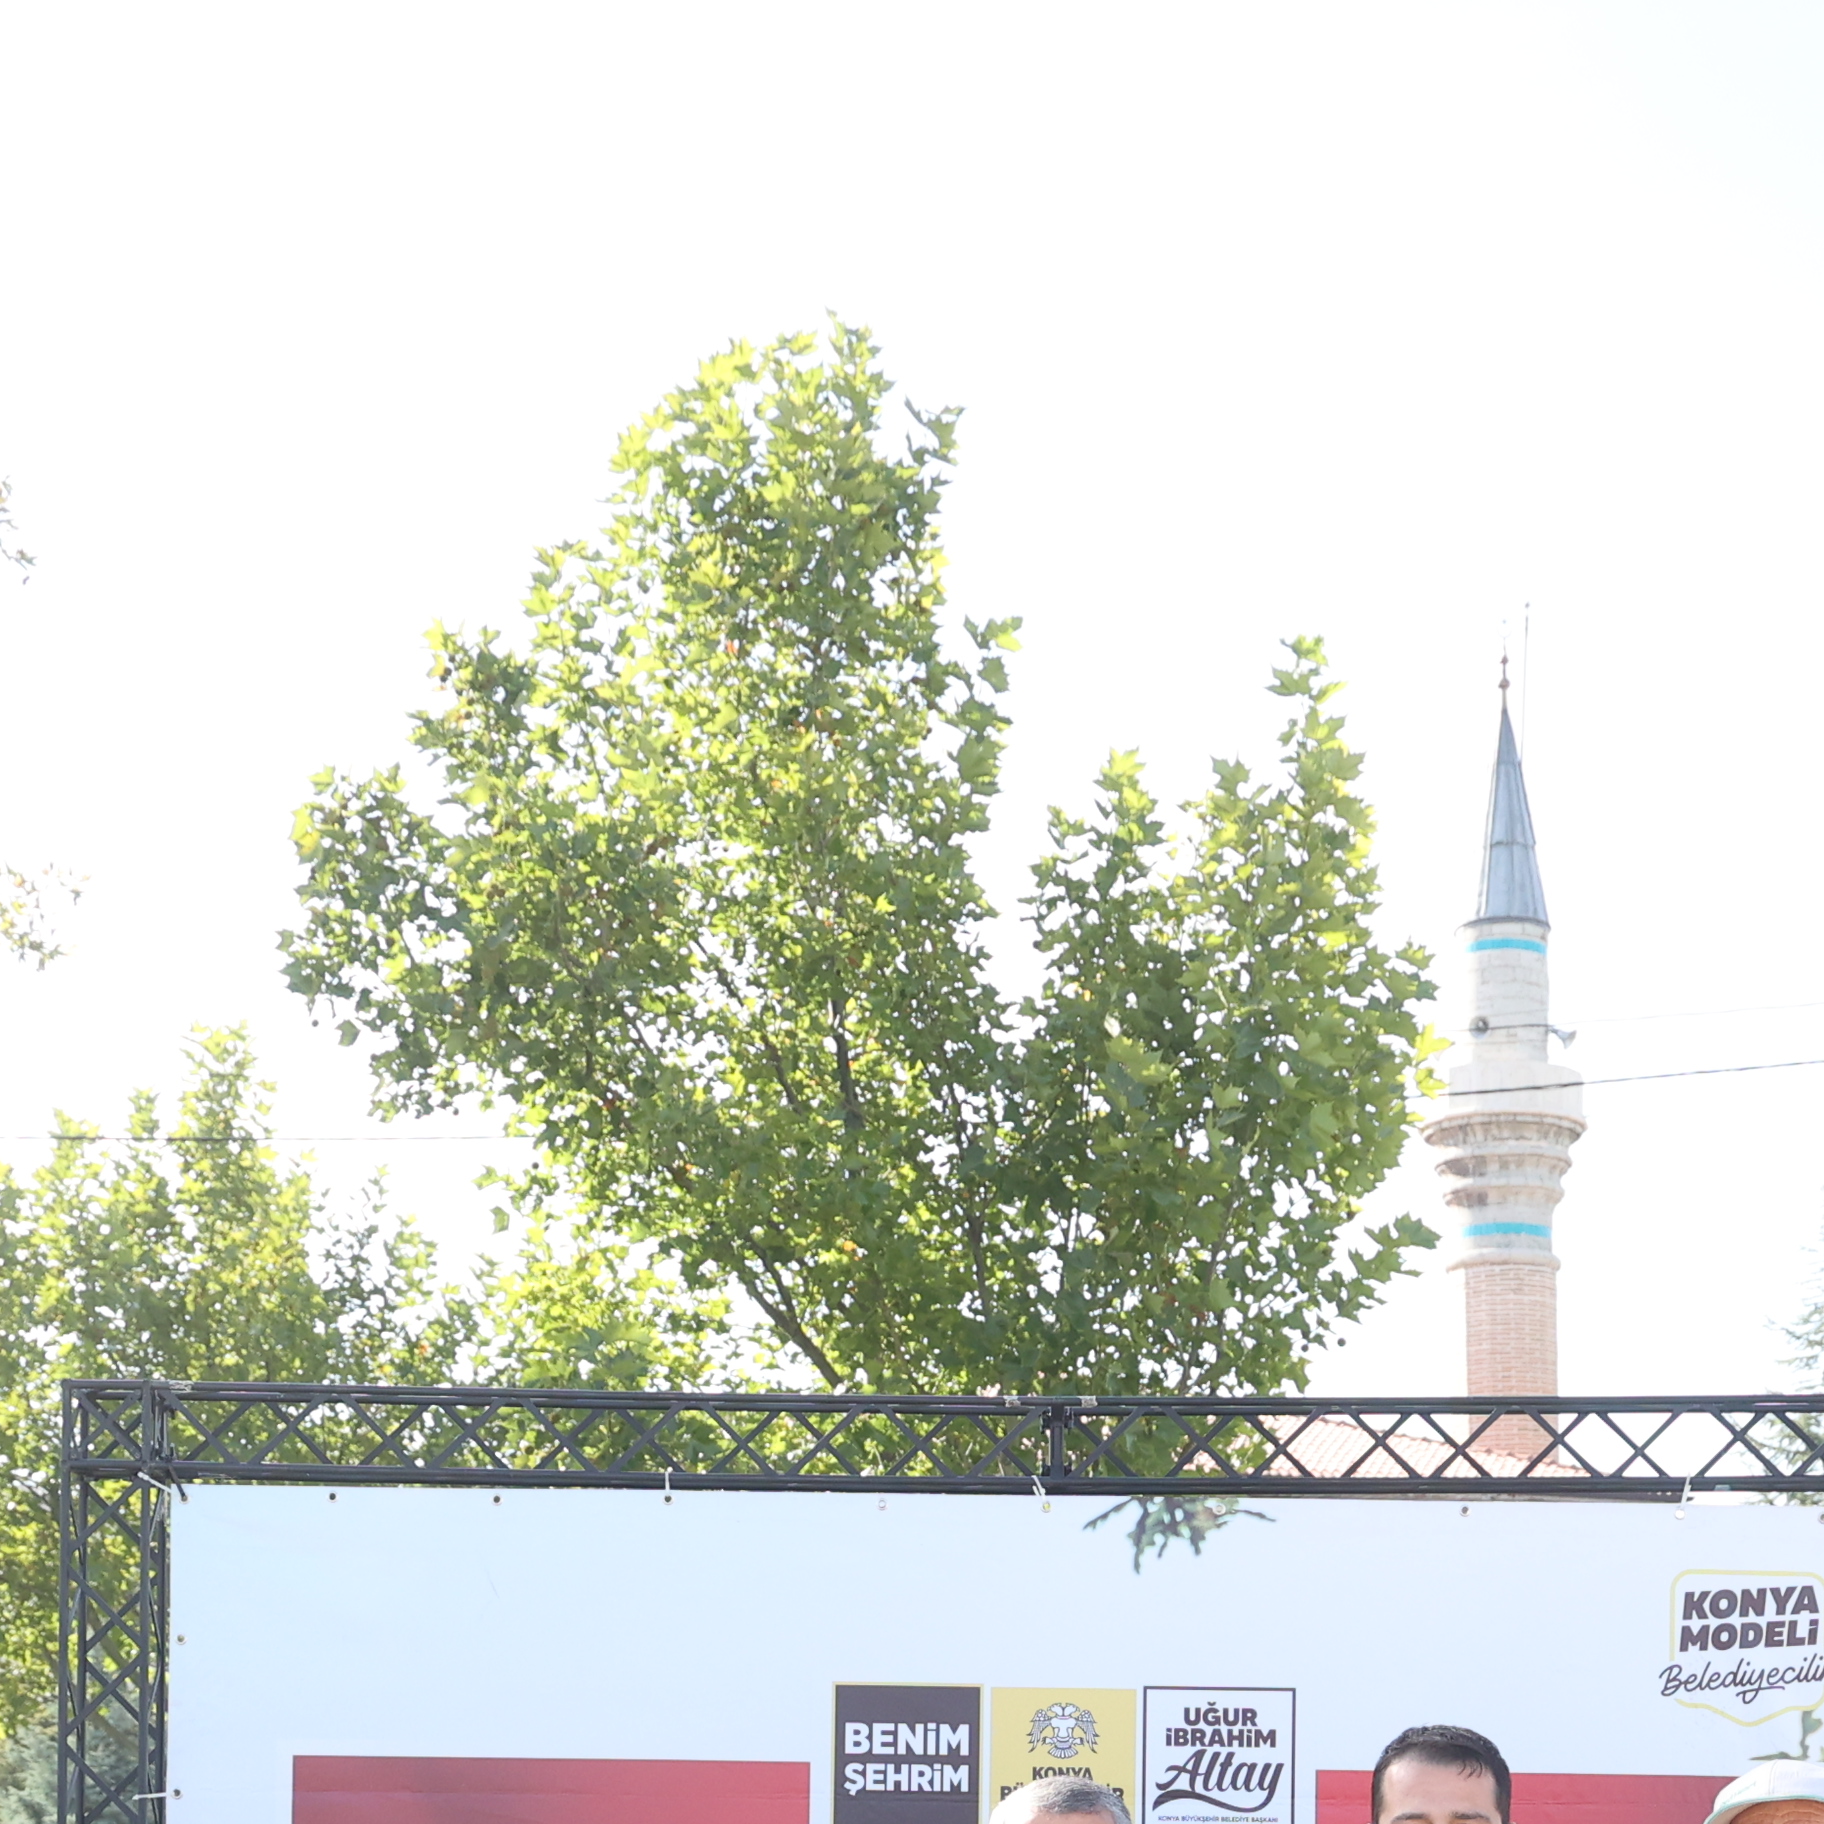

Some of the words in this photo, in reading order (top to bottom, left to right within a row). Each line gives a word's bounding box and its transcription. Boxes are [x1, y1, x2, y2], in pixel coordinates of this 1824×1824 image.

[1683, 1586, 1819, 1620] KONYA
[1183, 1702, 1257, 1726] UĞUR
[1032, 1766, 1093, 1781] KONYA
[1154, 1749, 1284, 1812] Altay
